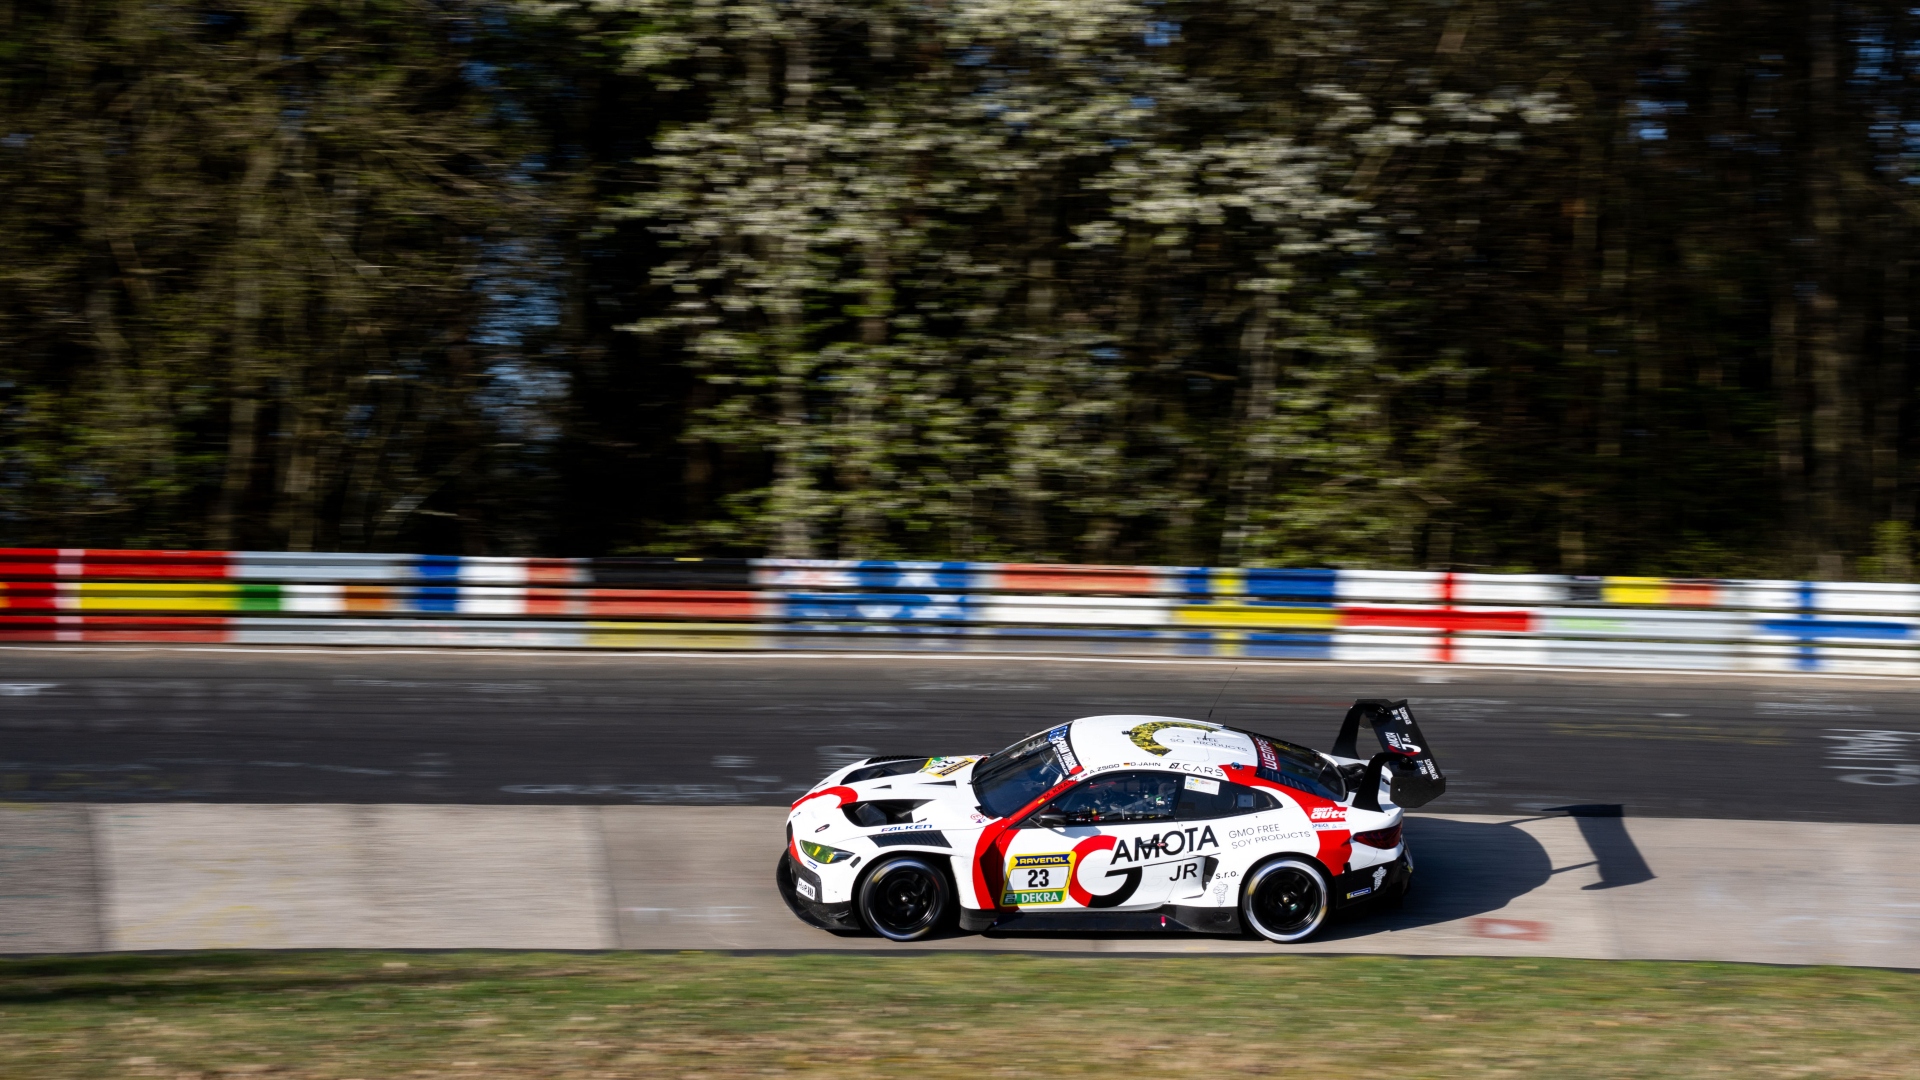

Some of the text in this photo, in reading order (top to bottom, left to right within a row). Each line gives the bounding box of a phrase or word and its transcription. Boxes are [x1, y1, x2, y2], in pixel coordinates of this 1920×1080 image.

[1193, 740, 1248, 752] PRODUCTS
[1183, 763, 1224, 777] CARS
[1310, 810, 1348, 819] auto
[881, 824, 933, 833] FALKEN
[1228, 823, 1280, 839] GMO FREE
[1231, 830, 1311, 850] SOY PRODUCTS
[1019, 856, 1067, 865] RAVENOL
[1027, 869, 1050, 888] 23
[1169, 863, 1239, 882] JR s.r.o.
[1021, 892, 1060, 903] DEKRA
